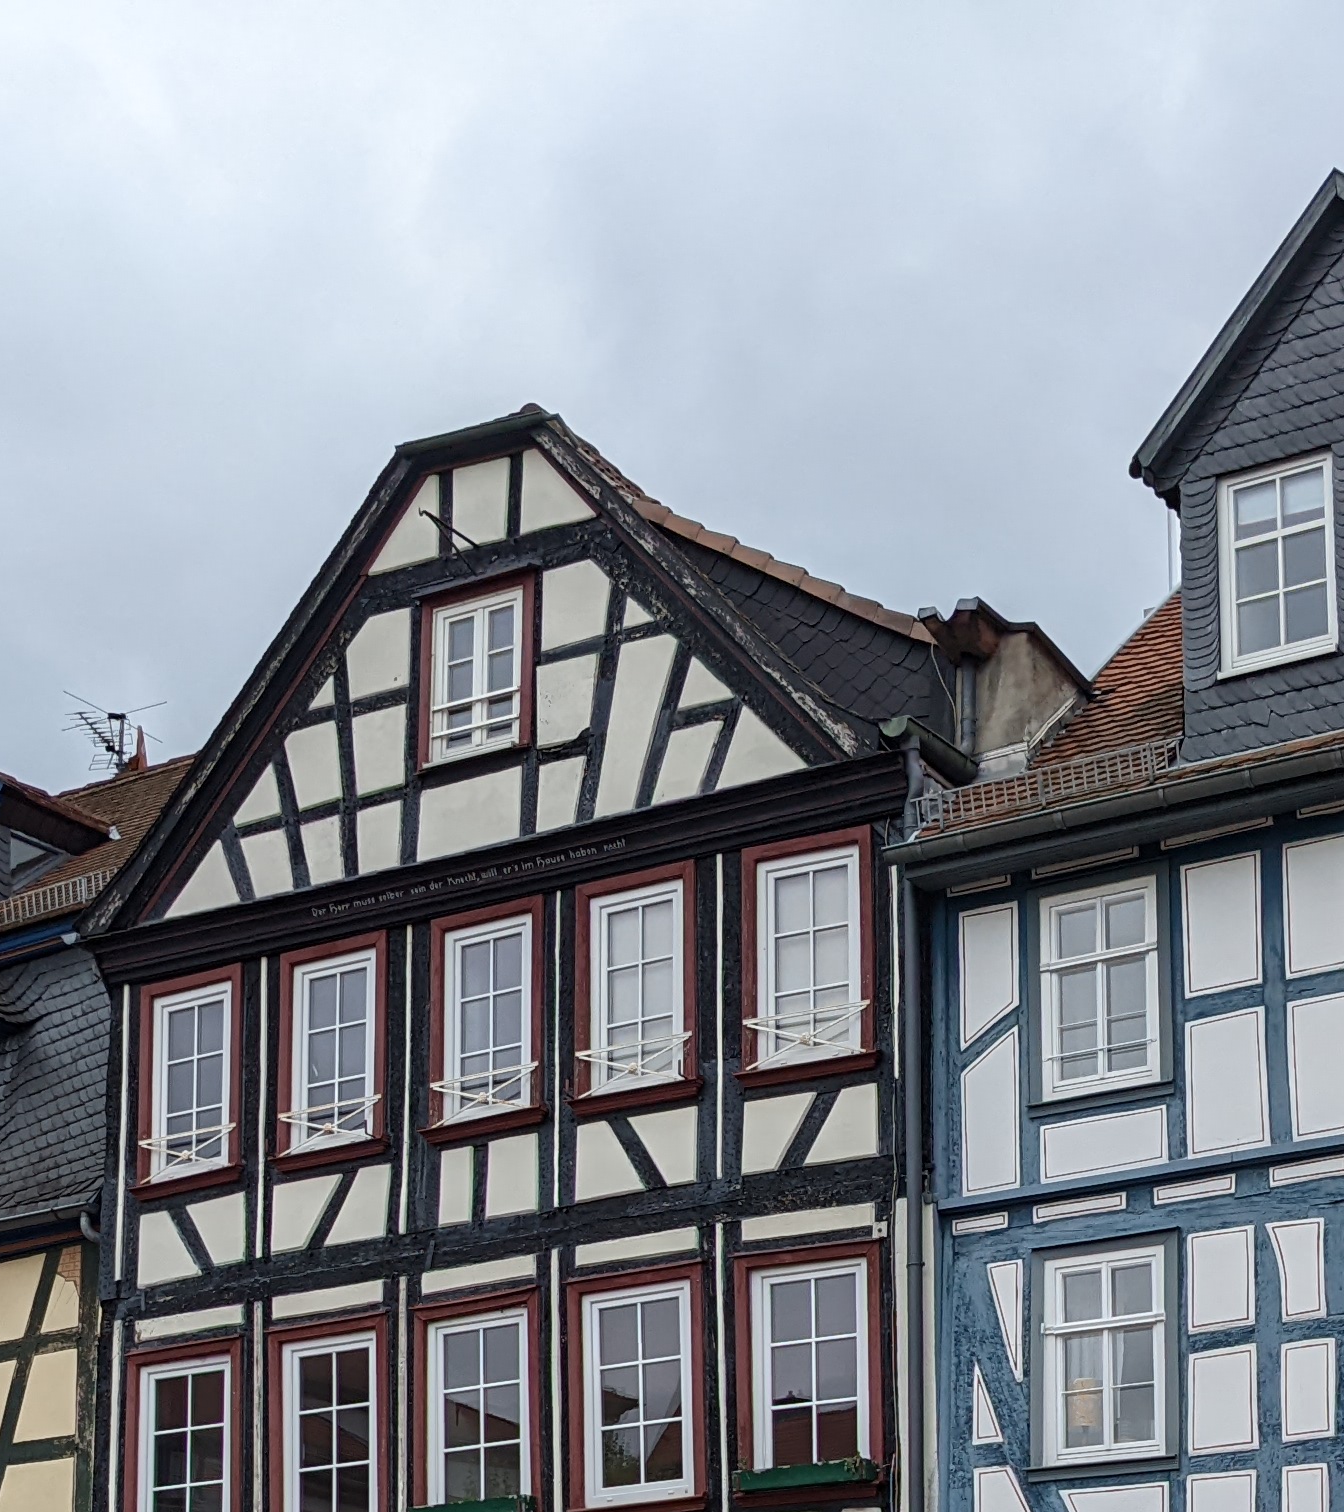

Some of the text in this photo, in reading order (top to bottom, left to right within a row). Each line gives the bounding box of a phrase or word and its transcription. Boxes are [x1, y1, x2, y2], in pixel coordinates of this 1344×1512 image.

[311, 907, 326, 918] Der
[329, 902, 351, 915] Herr
[353, 896, 375, 908] muss
[429, 880, 444, 891] der
[536, 853, 566, 868] Hause
[568, 847, 598, 859] haben
